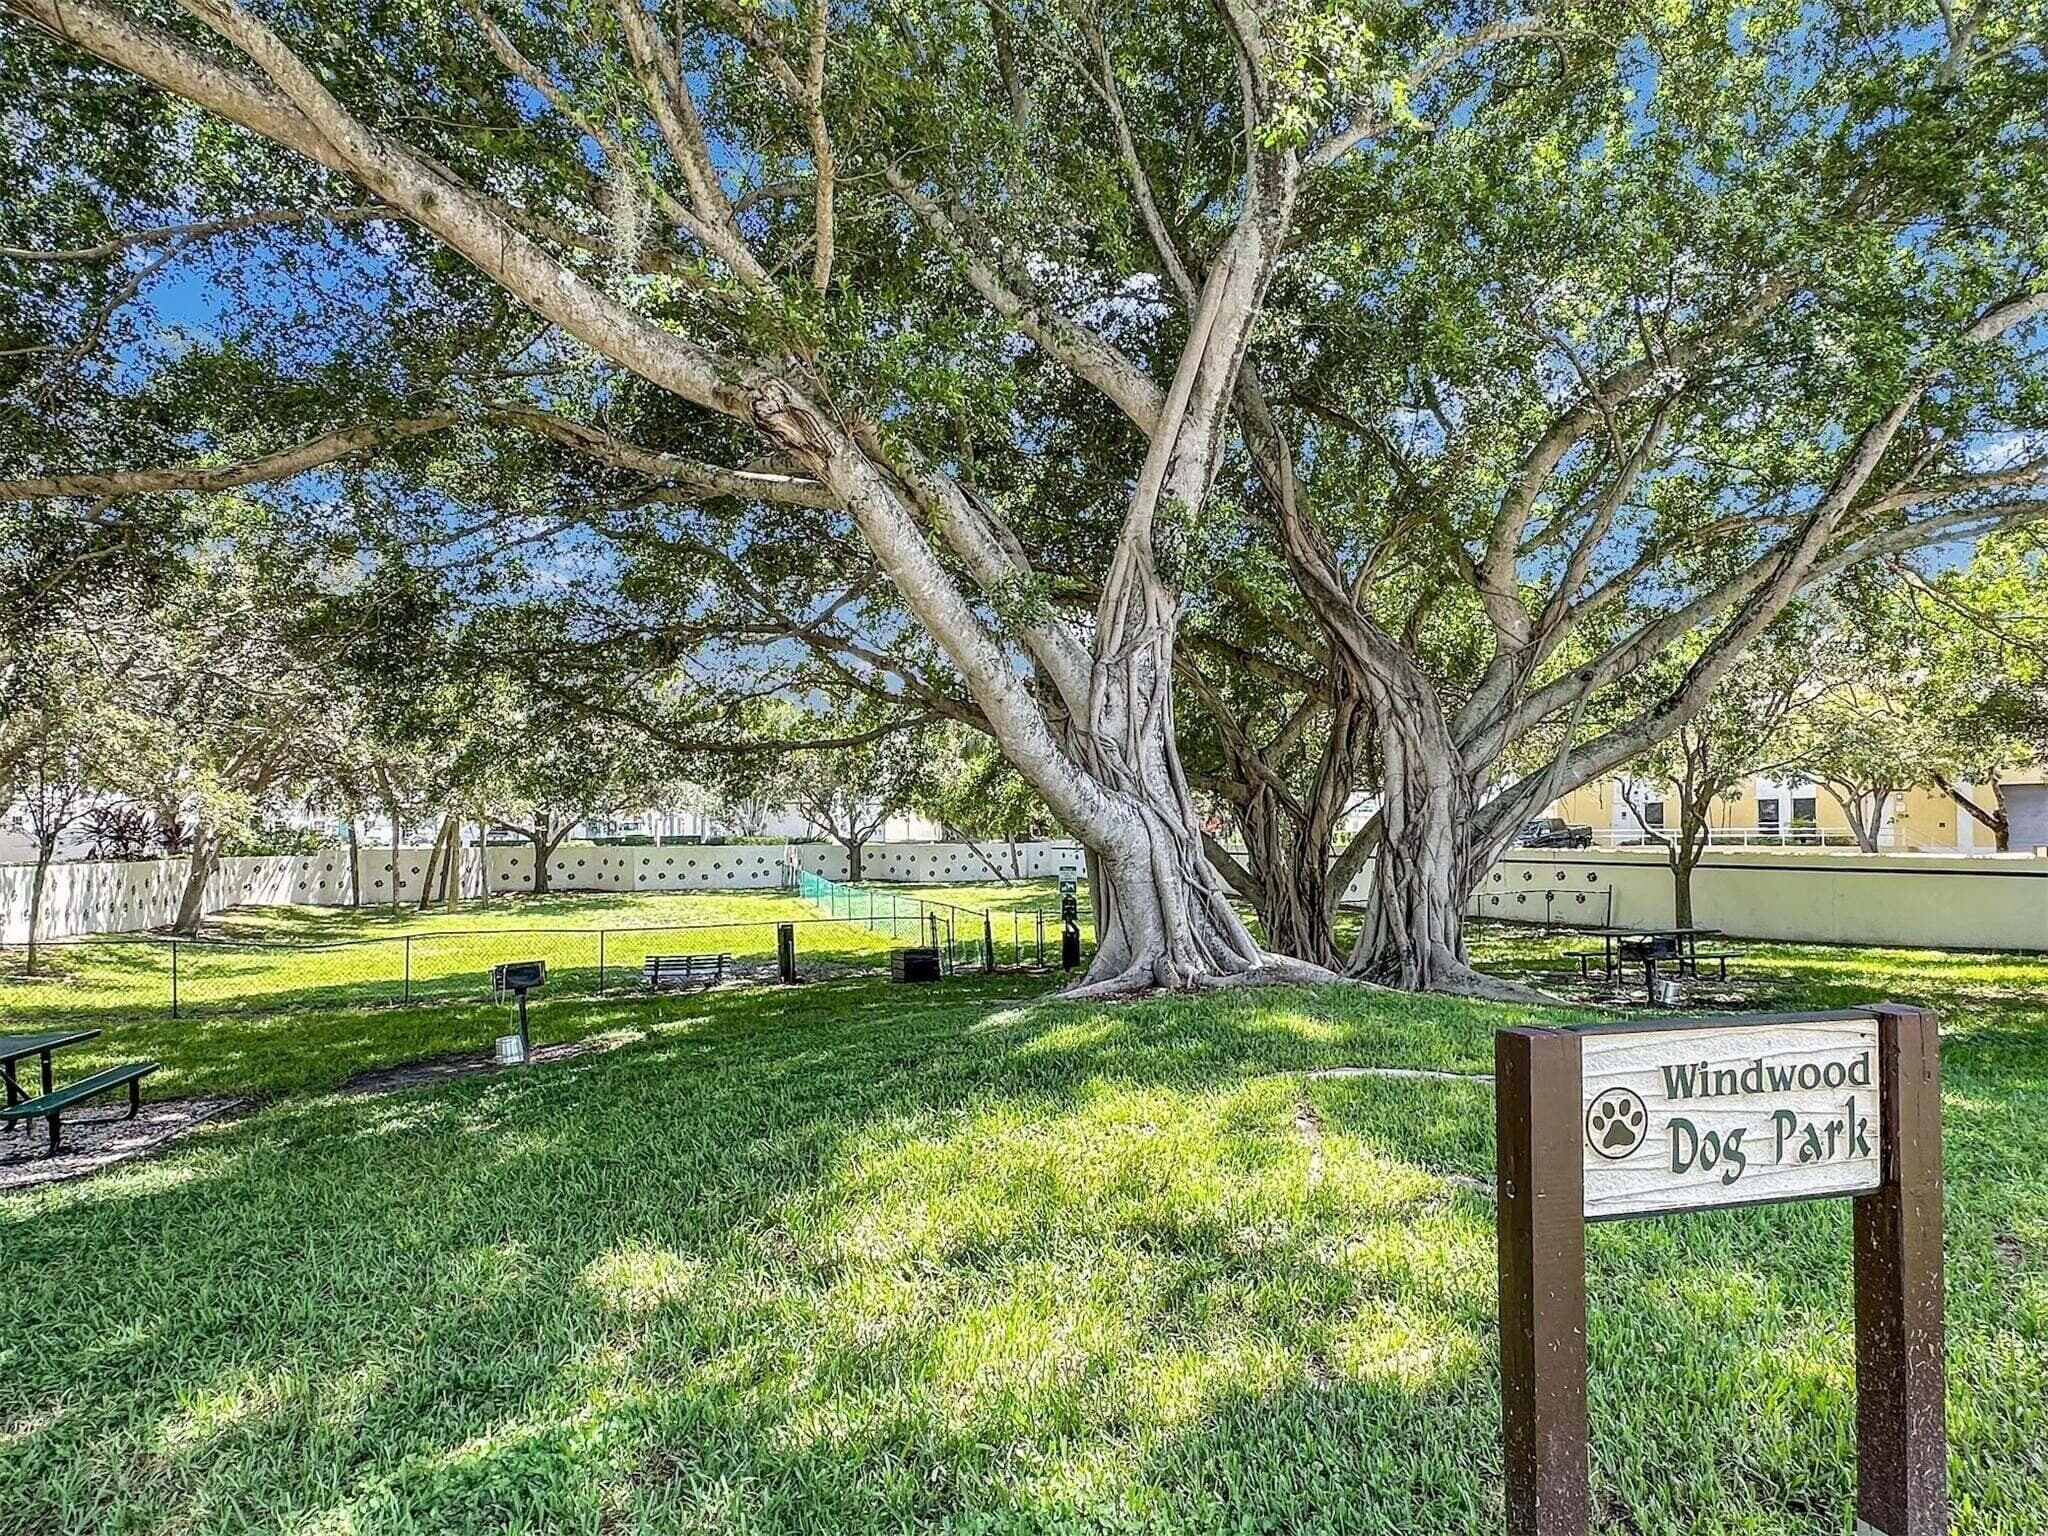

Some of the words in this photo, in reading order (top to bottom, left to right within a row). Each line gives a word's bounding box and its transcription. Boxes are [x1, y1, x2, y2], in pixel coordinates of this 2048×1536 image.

[1662, 1052, 1871, 1099] Windwood
[1667, 1117, 1747, 1186] Dog
[1771, 1097, 1871, 1165] Park
